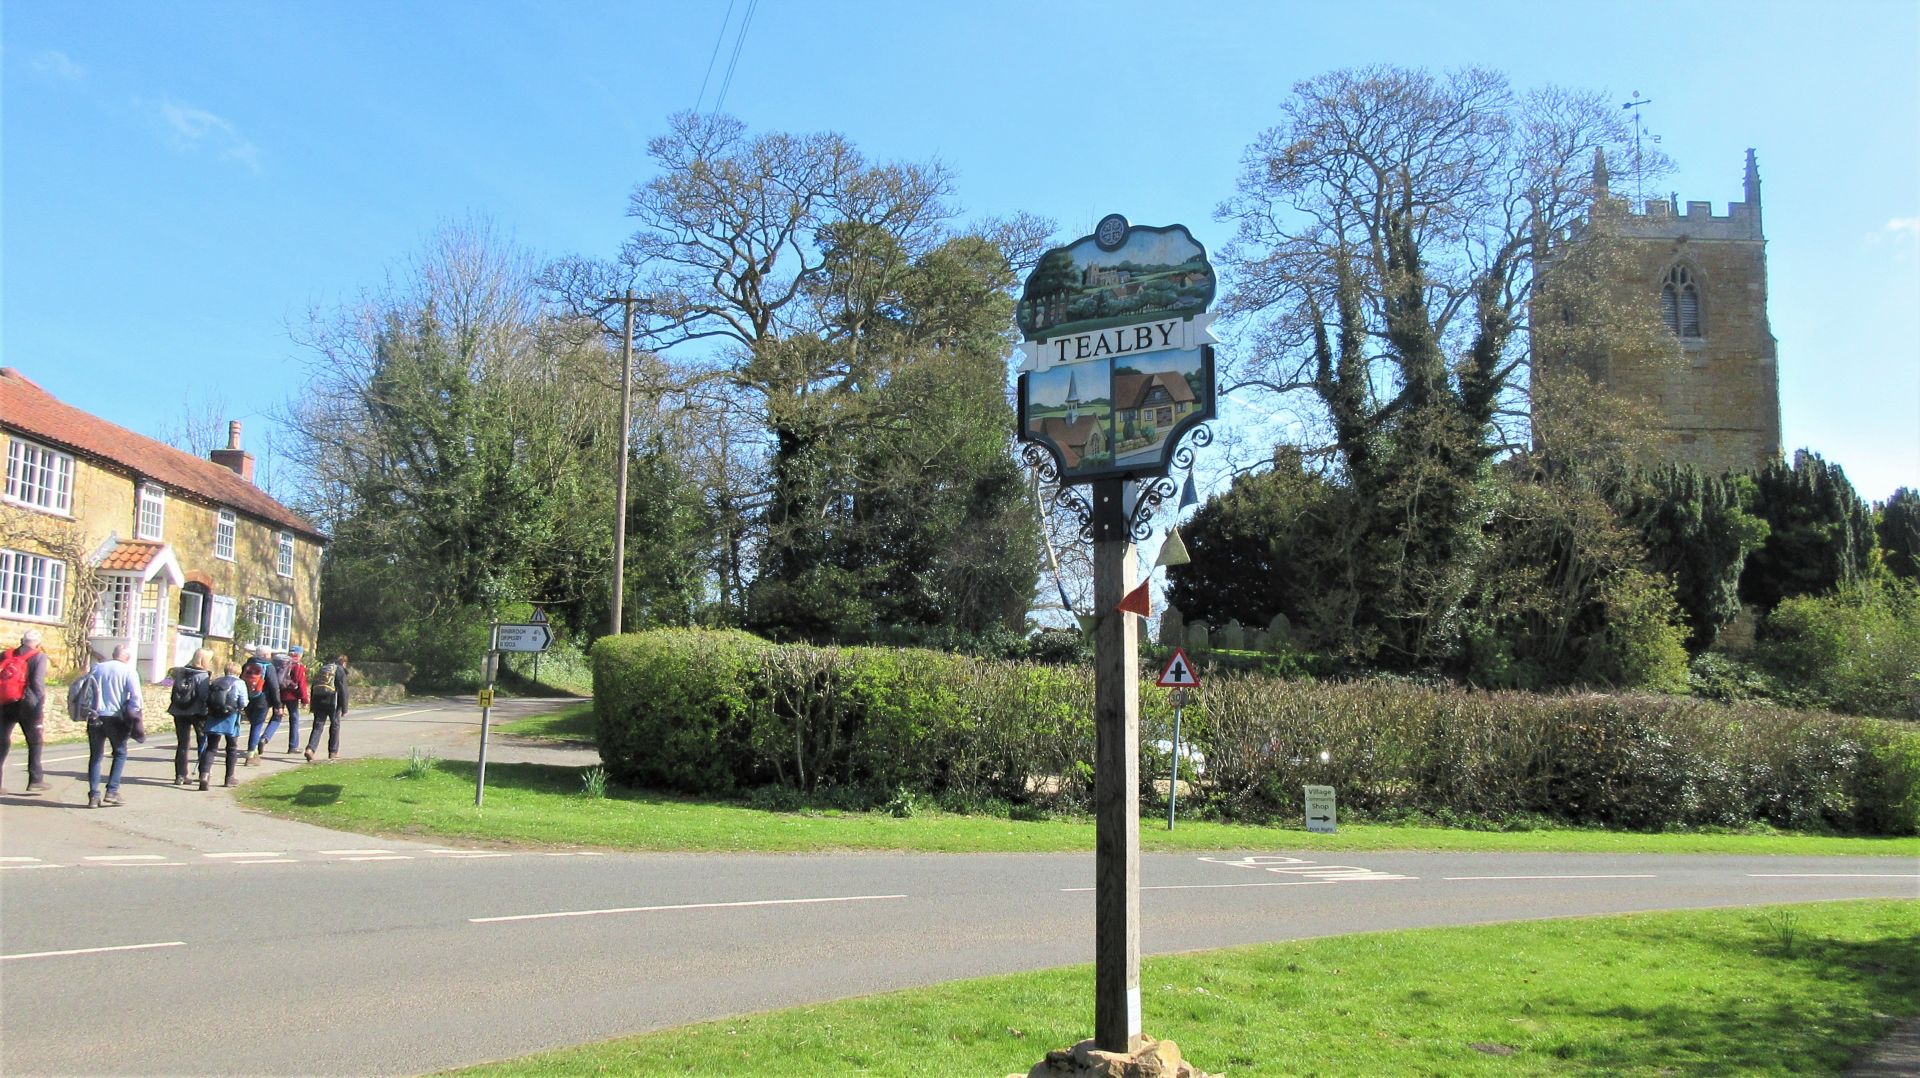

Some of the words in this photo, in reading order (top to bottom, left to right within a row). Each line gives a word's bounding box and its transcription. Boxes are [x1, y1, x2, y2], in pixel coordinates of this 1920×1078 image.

[1054, 321, 1177, 361] TEALBY
[480, 691, 491, 705] H
[1170, 693, 1181, 702] 30
[1308, 788, 1332, 796] Village
